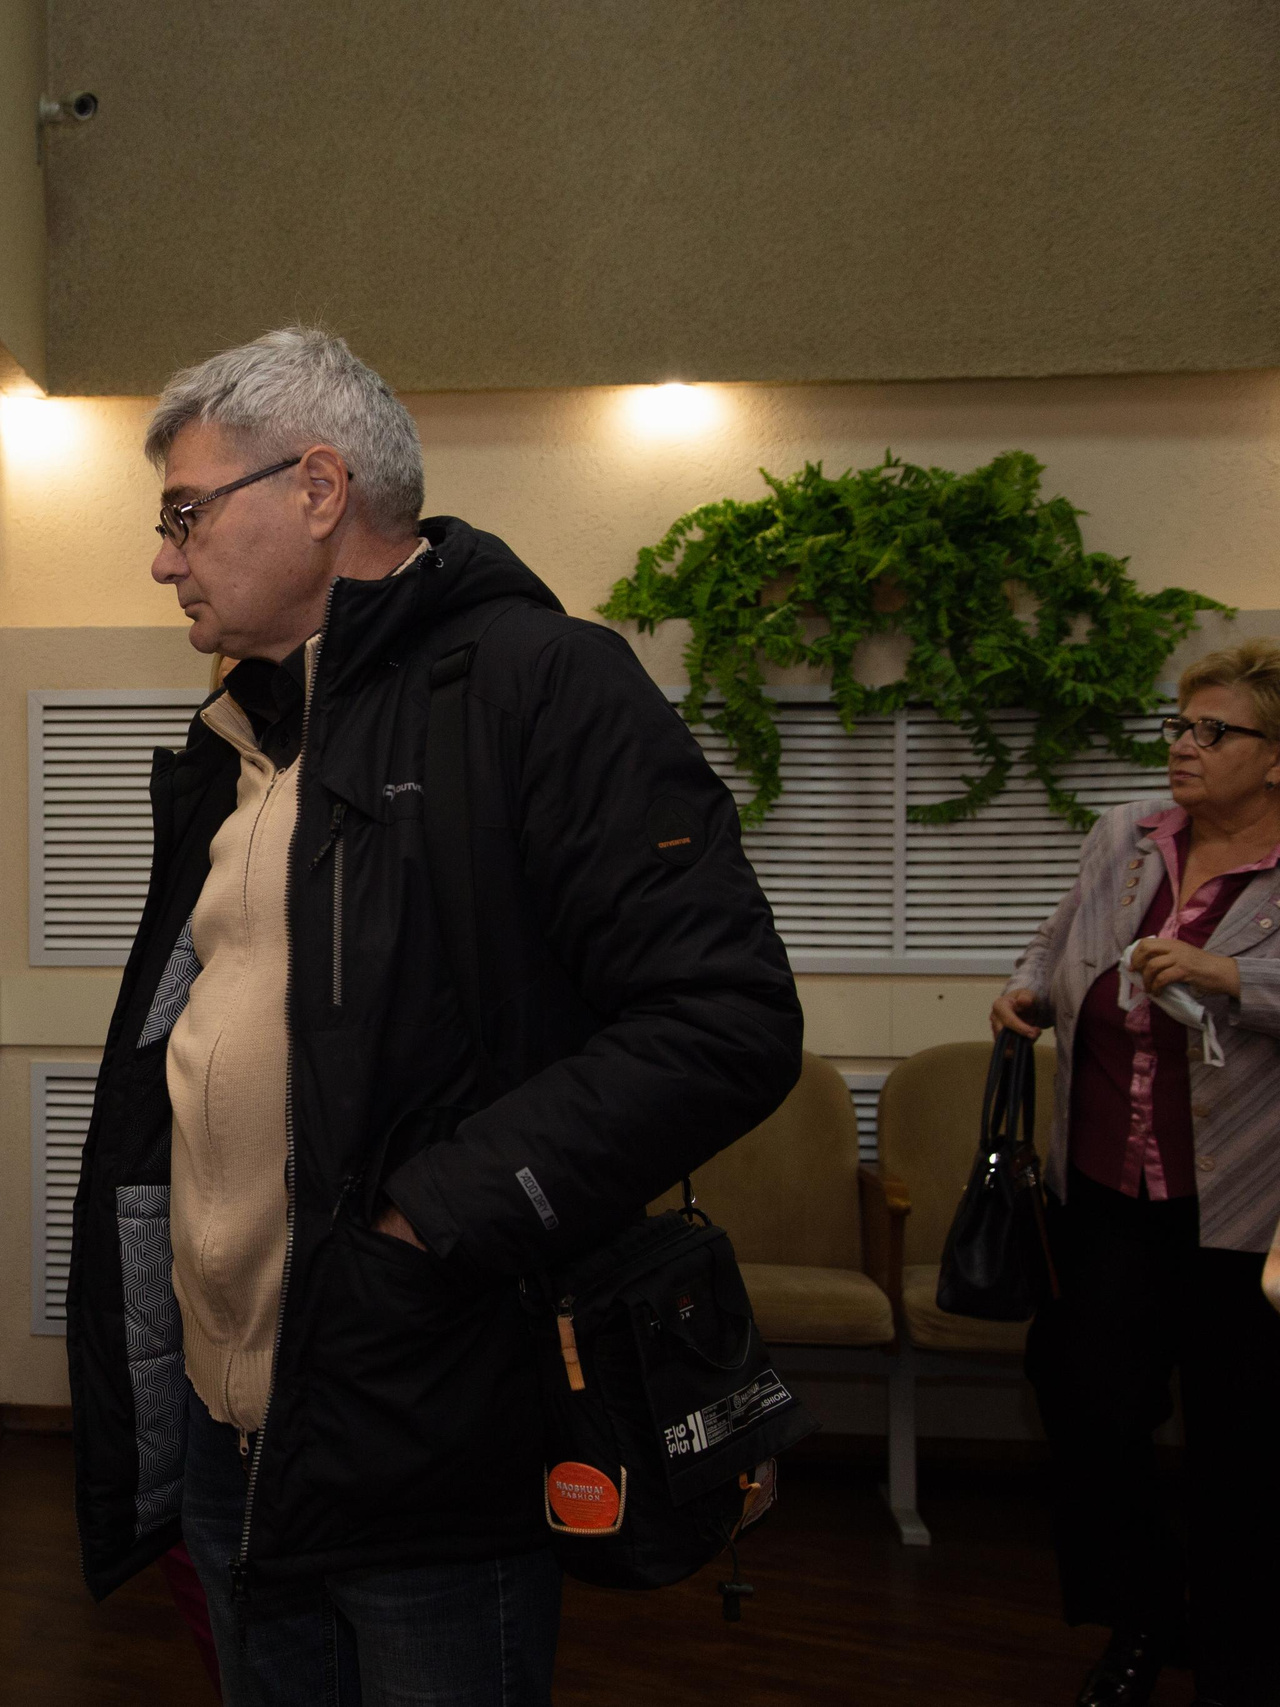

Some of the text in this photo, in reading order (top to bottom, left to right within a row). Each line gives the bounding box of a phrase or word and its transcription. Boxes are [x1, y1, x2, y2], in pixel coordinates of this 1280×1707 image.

[533, 1194, 550, 1213] DRY
[760, 1390, 787, 1408] ASHION
[561, 1490, 600, 1501] FASHION
